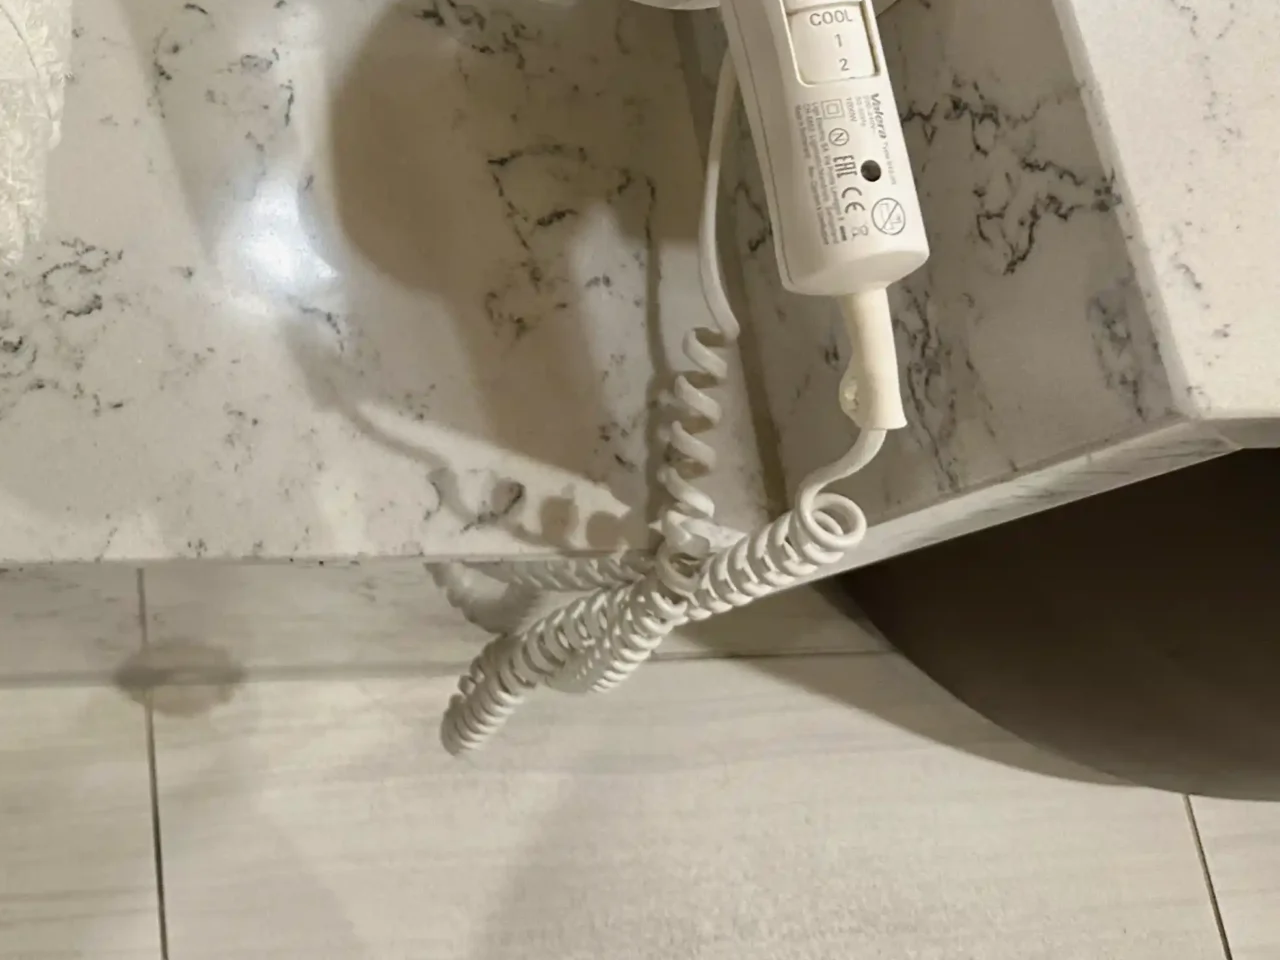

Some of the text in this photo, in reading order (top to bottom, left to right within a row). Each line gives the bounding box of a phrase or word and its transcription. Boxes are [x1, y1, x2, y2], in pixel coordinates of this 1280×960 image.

[809, 9, 853, 26] COOL
[835, 33, 843, 48] 1
[839, 58, 850, 72] 2
[841, 186, 866, 214] CE
